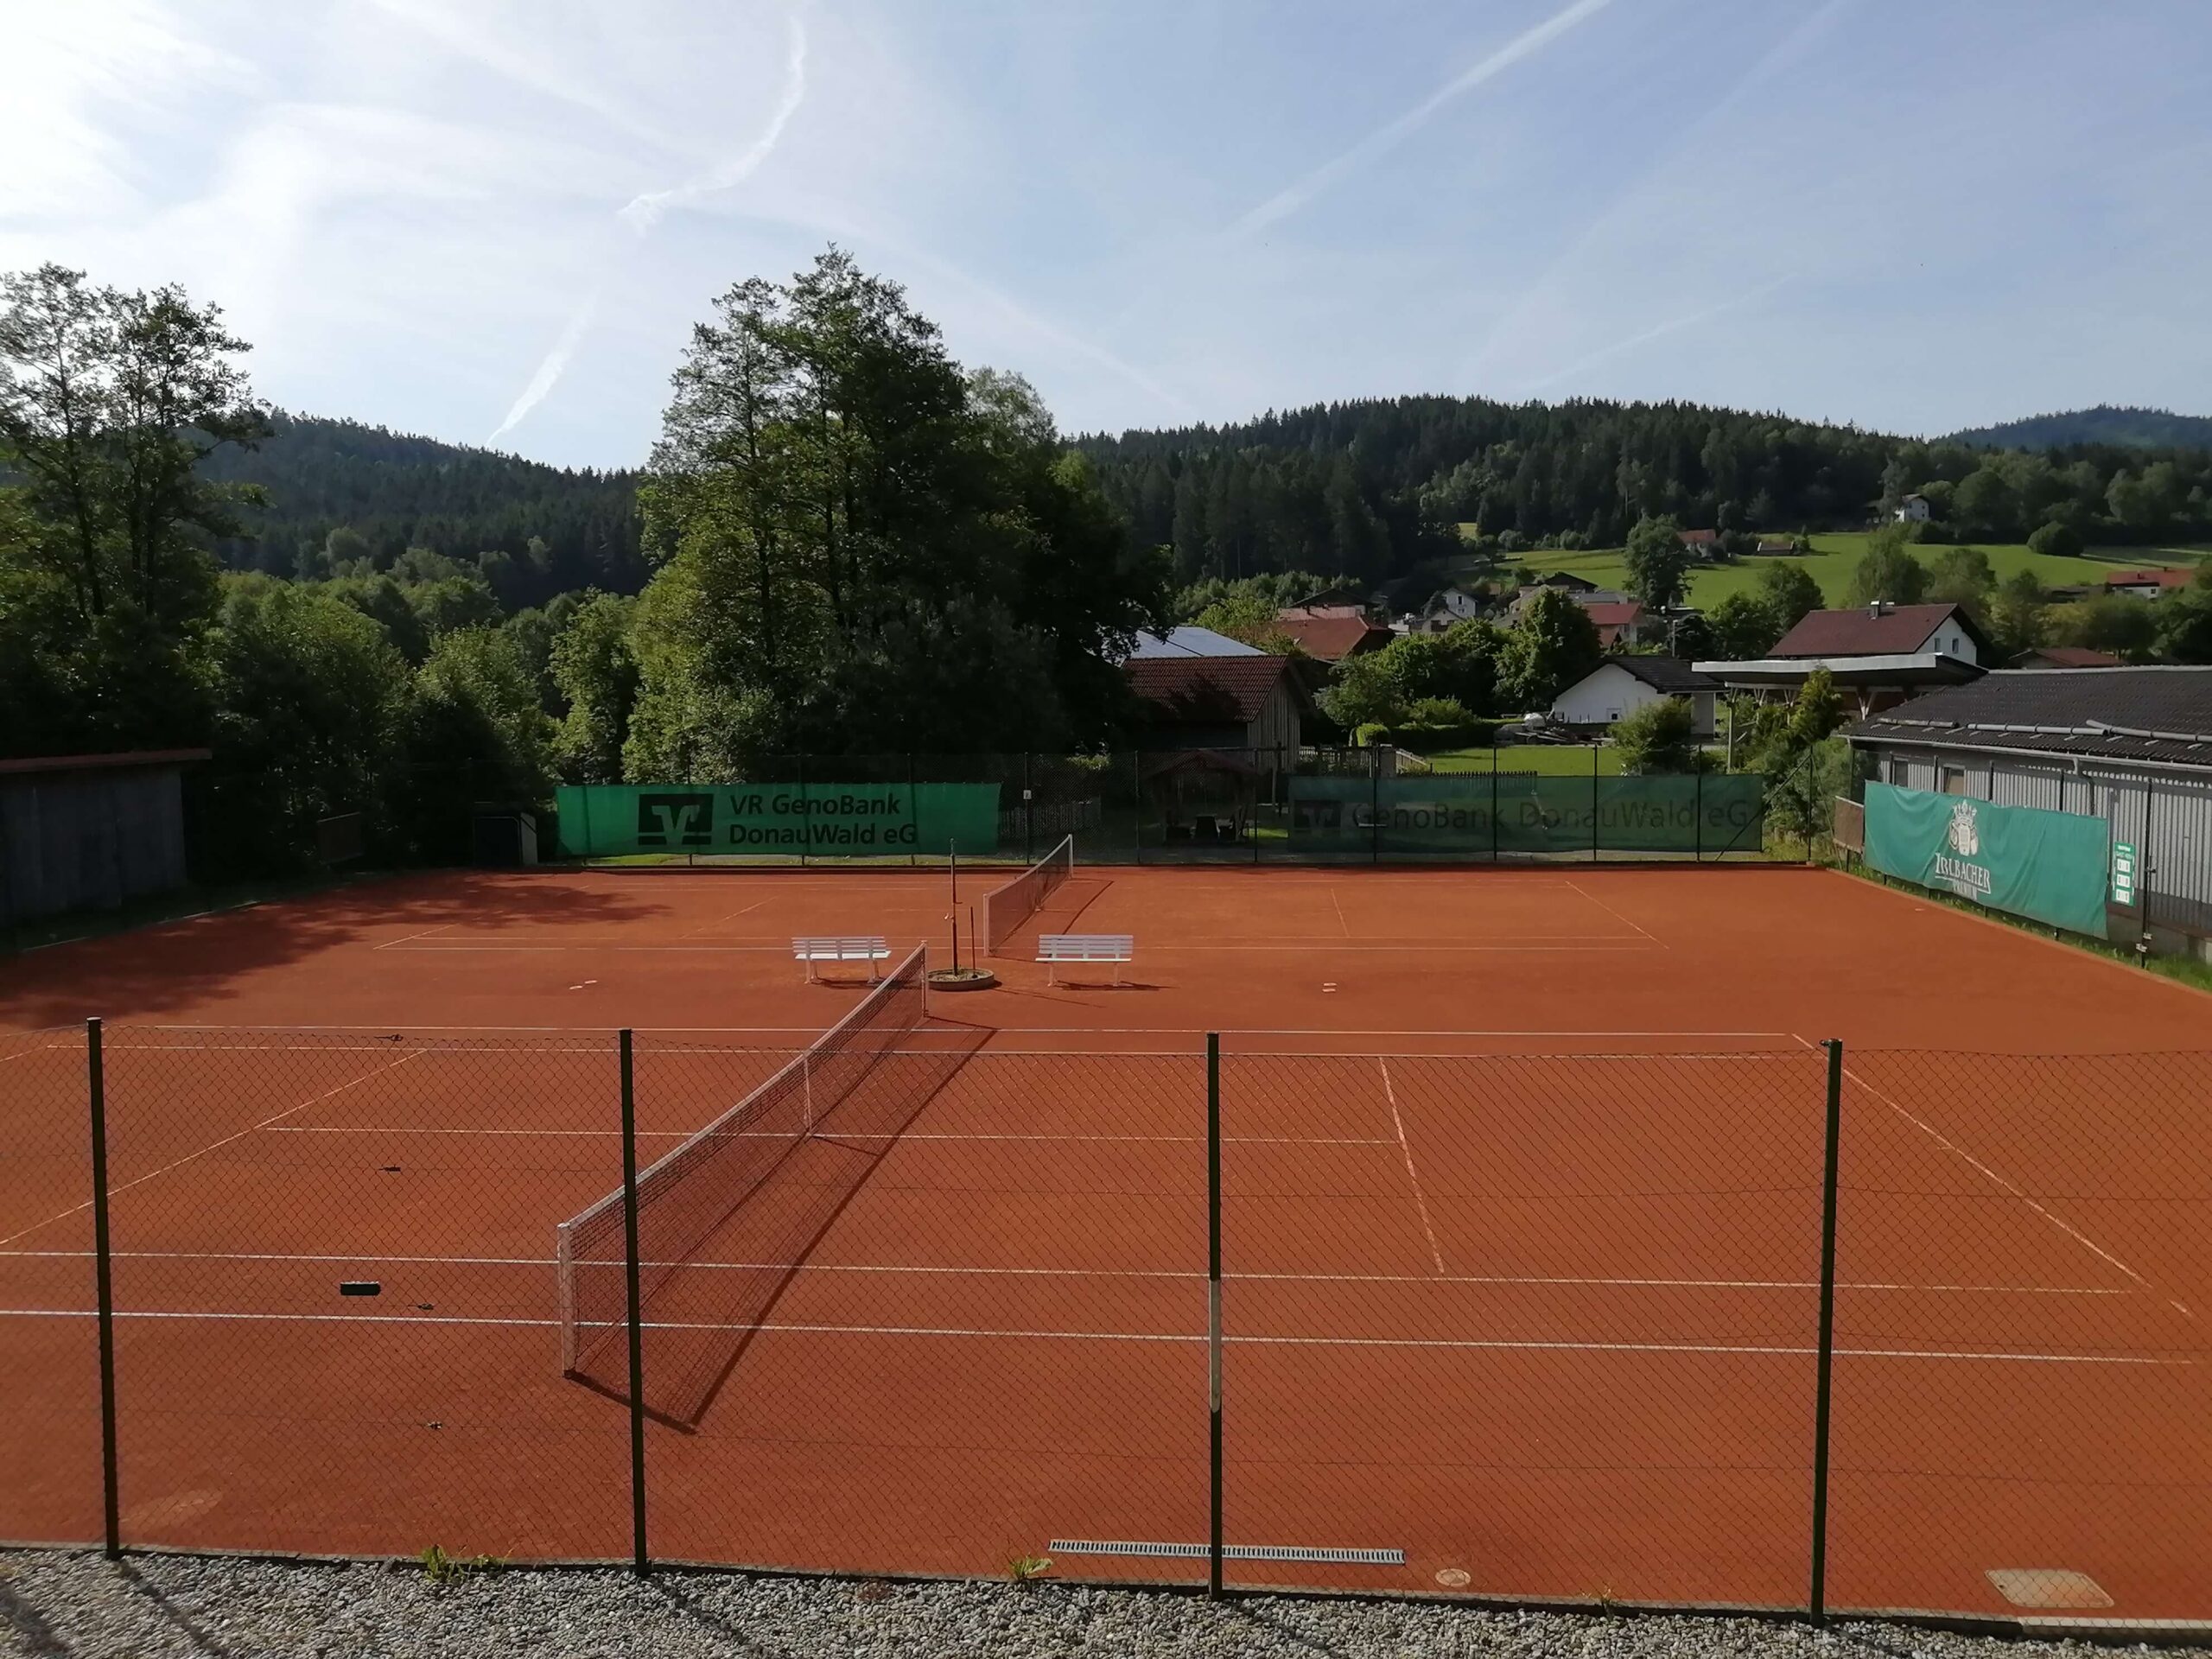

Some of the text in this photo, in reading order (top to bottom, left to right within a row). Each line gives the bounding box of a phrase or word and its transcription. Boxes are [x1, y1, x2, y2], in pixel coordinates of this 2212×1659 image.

[729, 792, 901, 815] VR GenoBank
[1352, 798, 1747, 830] GenoBank DonauWald eG
[730, 823, 917, 844] DonauWald eG
[1936, 853, 1991, 893] IRLBACHER
